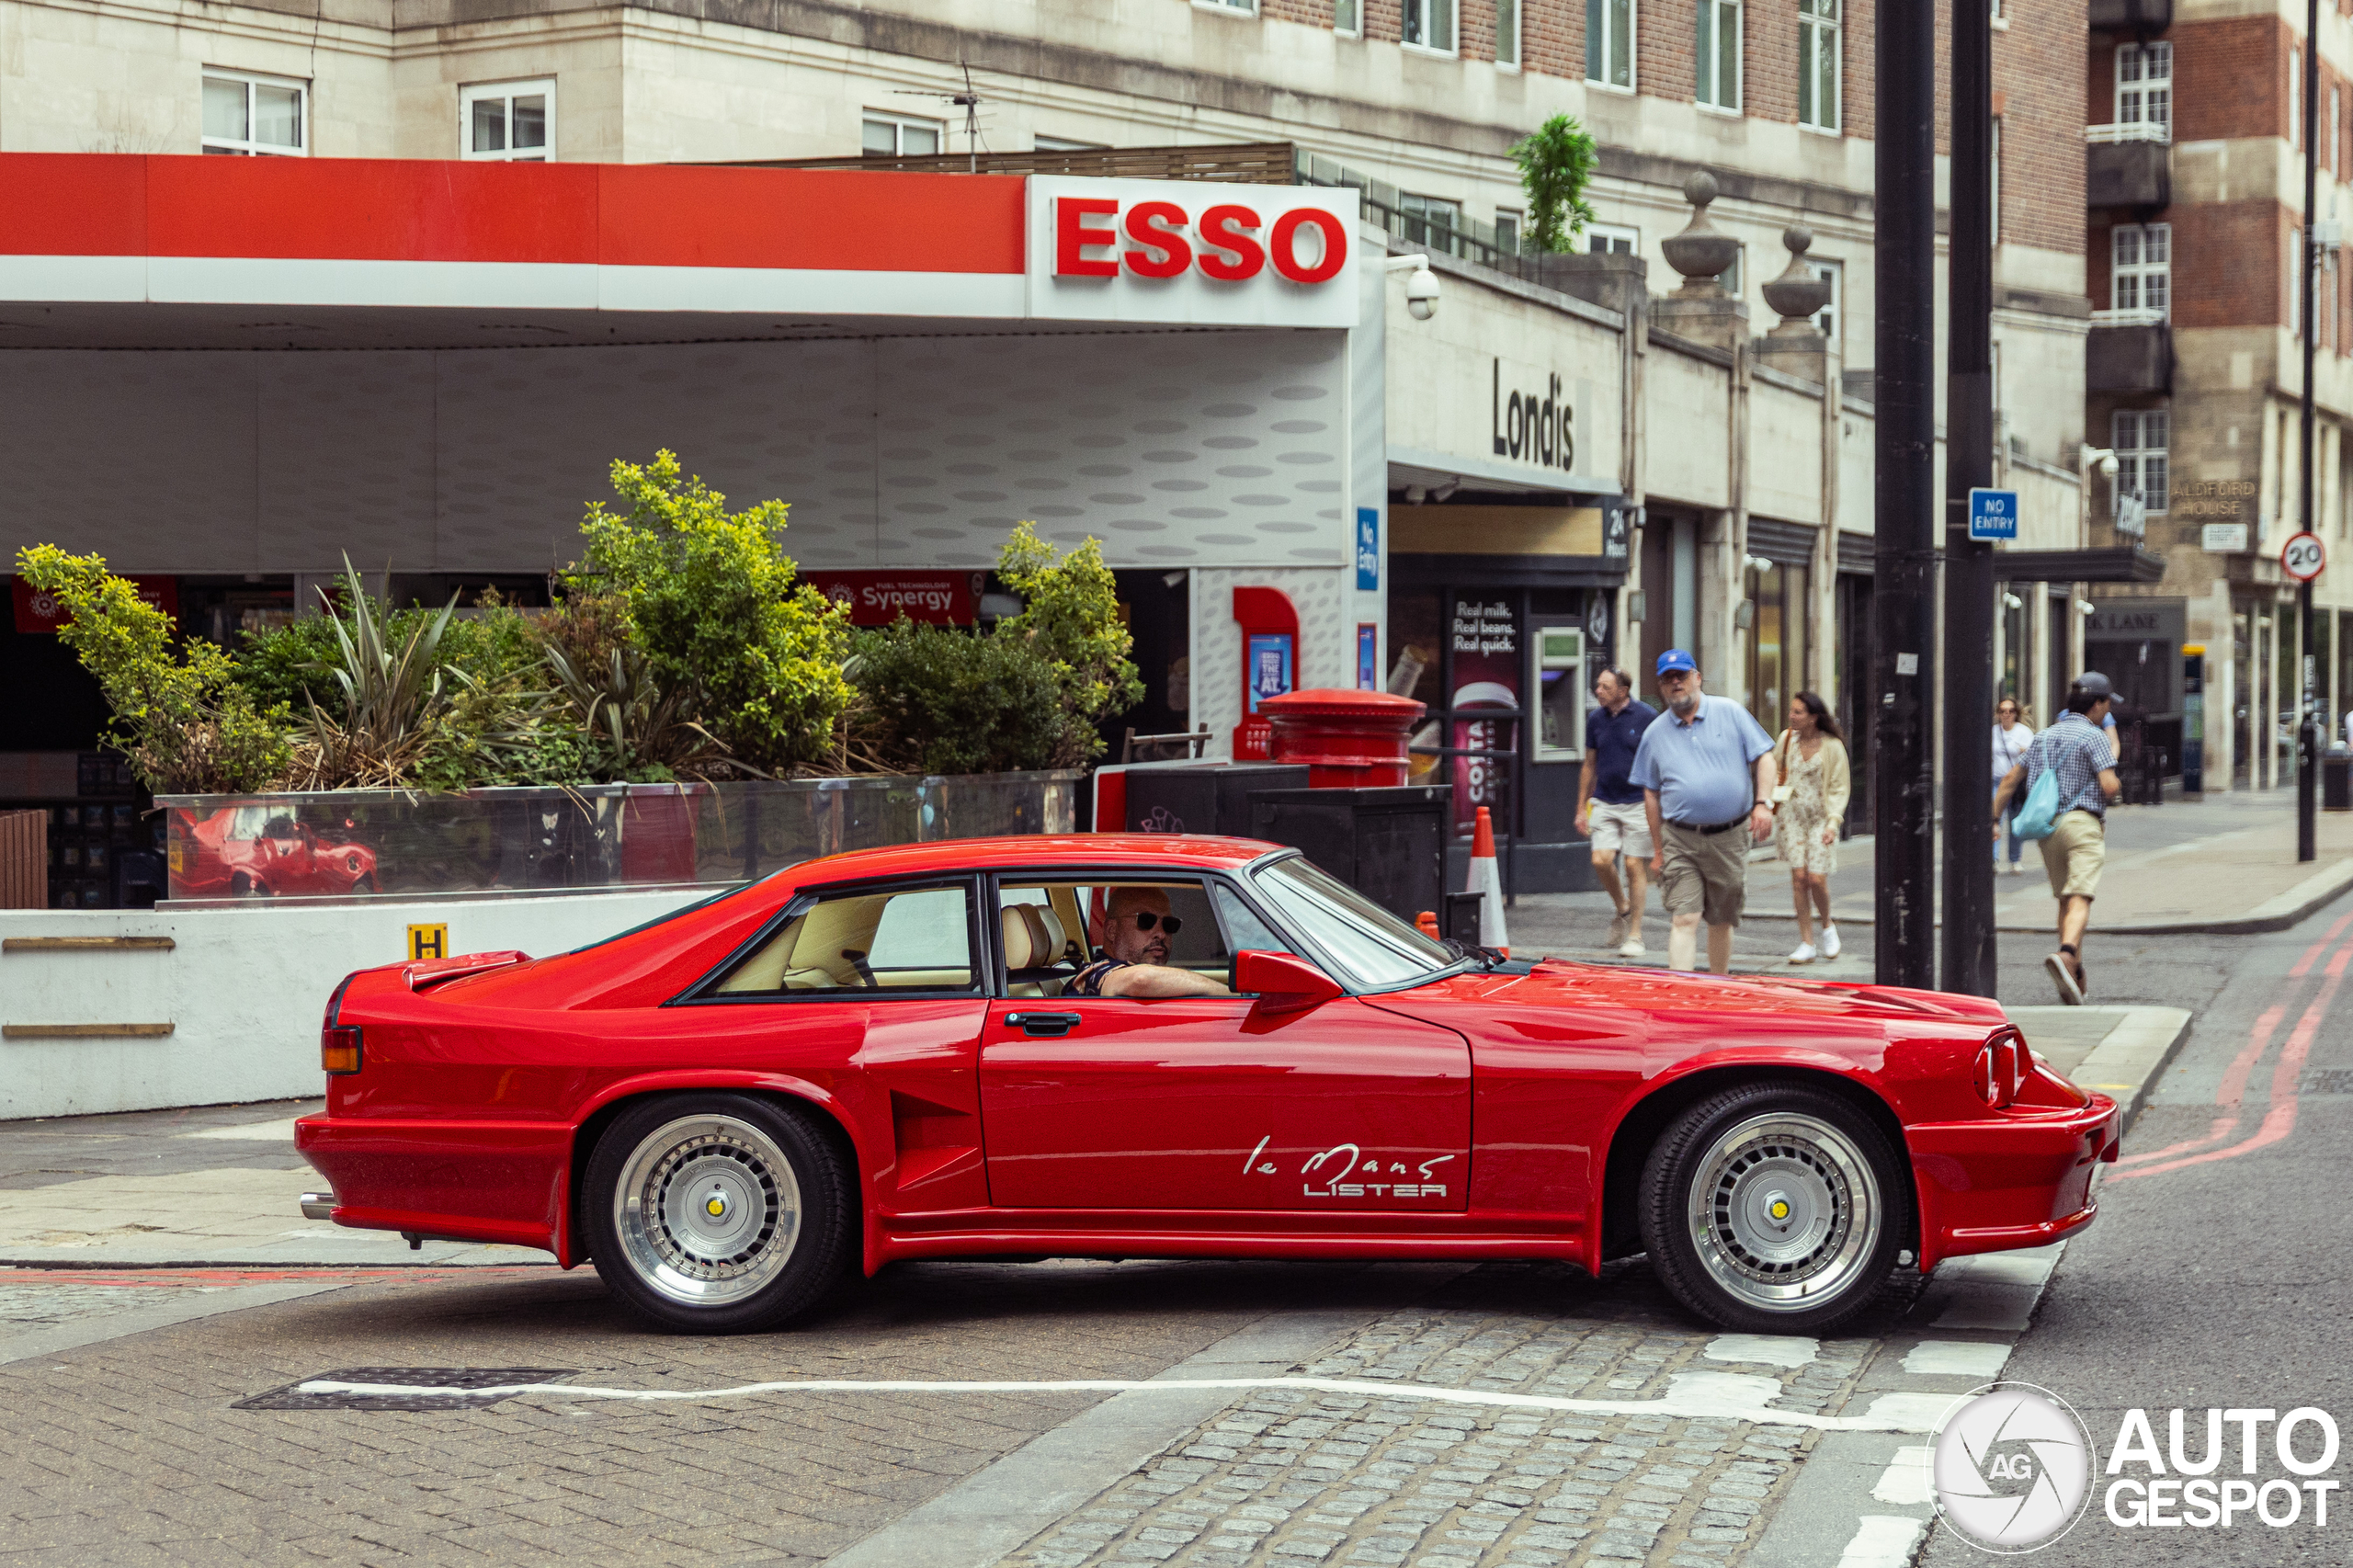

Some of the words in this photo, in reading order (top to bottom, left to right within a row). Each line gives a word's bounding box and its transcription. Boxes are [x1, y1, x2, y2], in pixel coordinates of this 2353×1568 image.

[1052, 196, 1347, 284] ESSO
[1493, 357, 1574, 472] Londis
[2172, 481, 2256, 497] ALDFORD
[1984, 498, 2005, 514] NO
[2182, 500, 2242, 516] HOUSE
[1361, 520, 1374, 544] No
[1974, 515, 2015, 531] ENTRY
[1358, 546, 1378, 577] Entry
[2289, 543, 2322, 566] 20
[862, 586, 952, 610] Synergy
[1456, 601, 1482, 619] Real
[1483, 602, 1513, 619] milk.
[1452, 618, 1478, 635] Real
[1481, 619, 1517, 635] beans.
[1453, 635, 1479, 653] Real
[1480, 635, 1516, 658] quick.
[415, 929, 441, 960] H
[1303, 1183, 1448, 1198] LISTER
